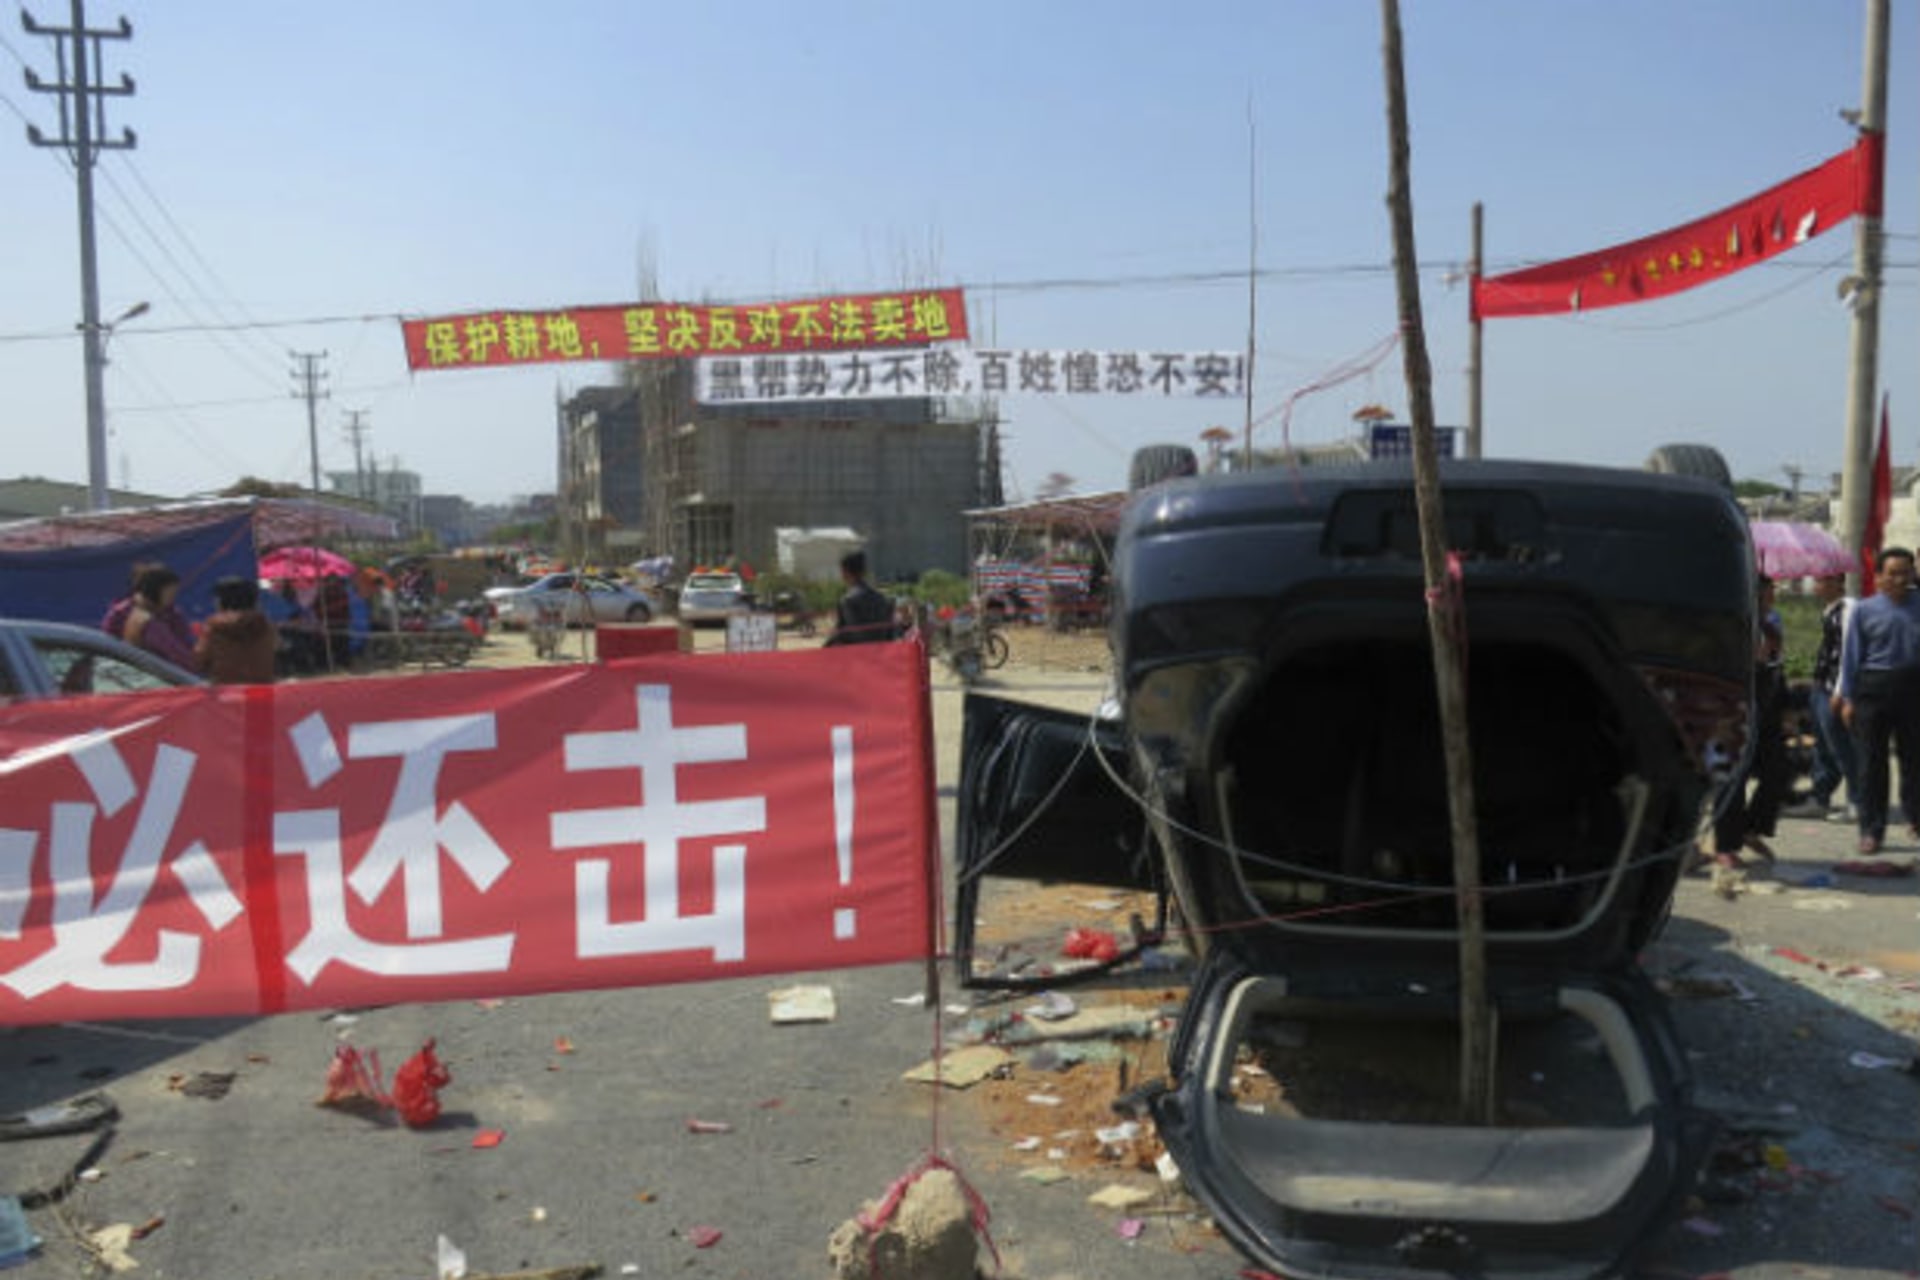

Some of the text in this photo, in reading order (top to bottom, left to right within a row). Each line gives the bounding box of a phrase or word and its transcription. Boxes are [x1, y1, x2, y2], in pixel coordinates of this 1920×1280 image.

[426, 294, 950, 366] 保护耕地，坚决反对不法卖地
